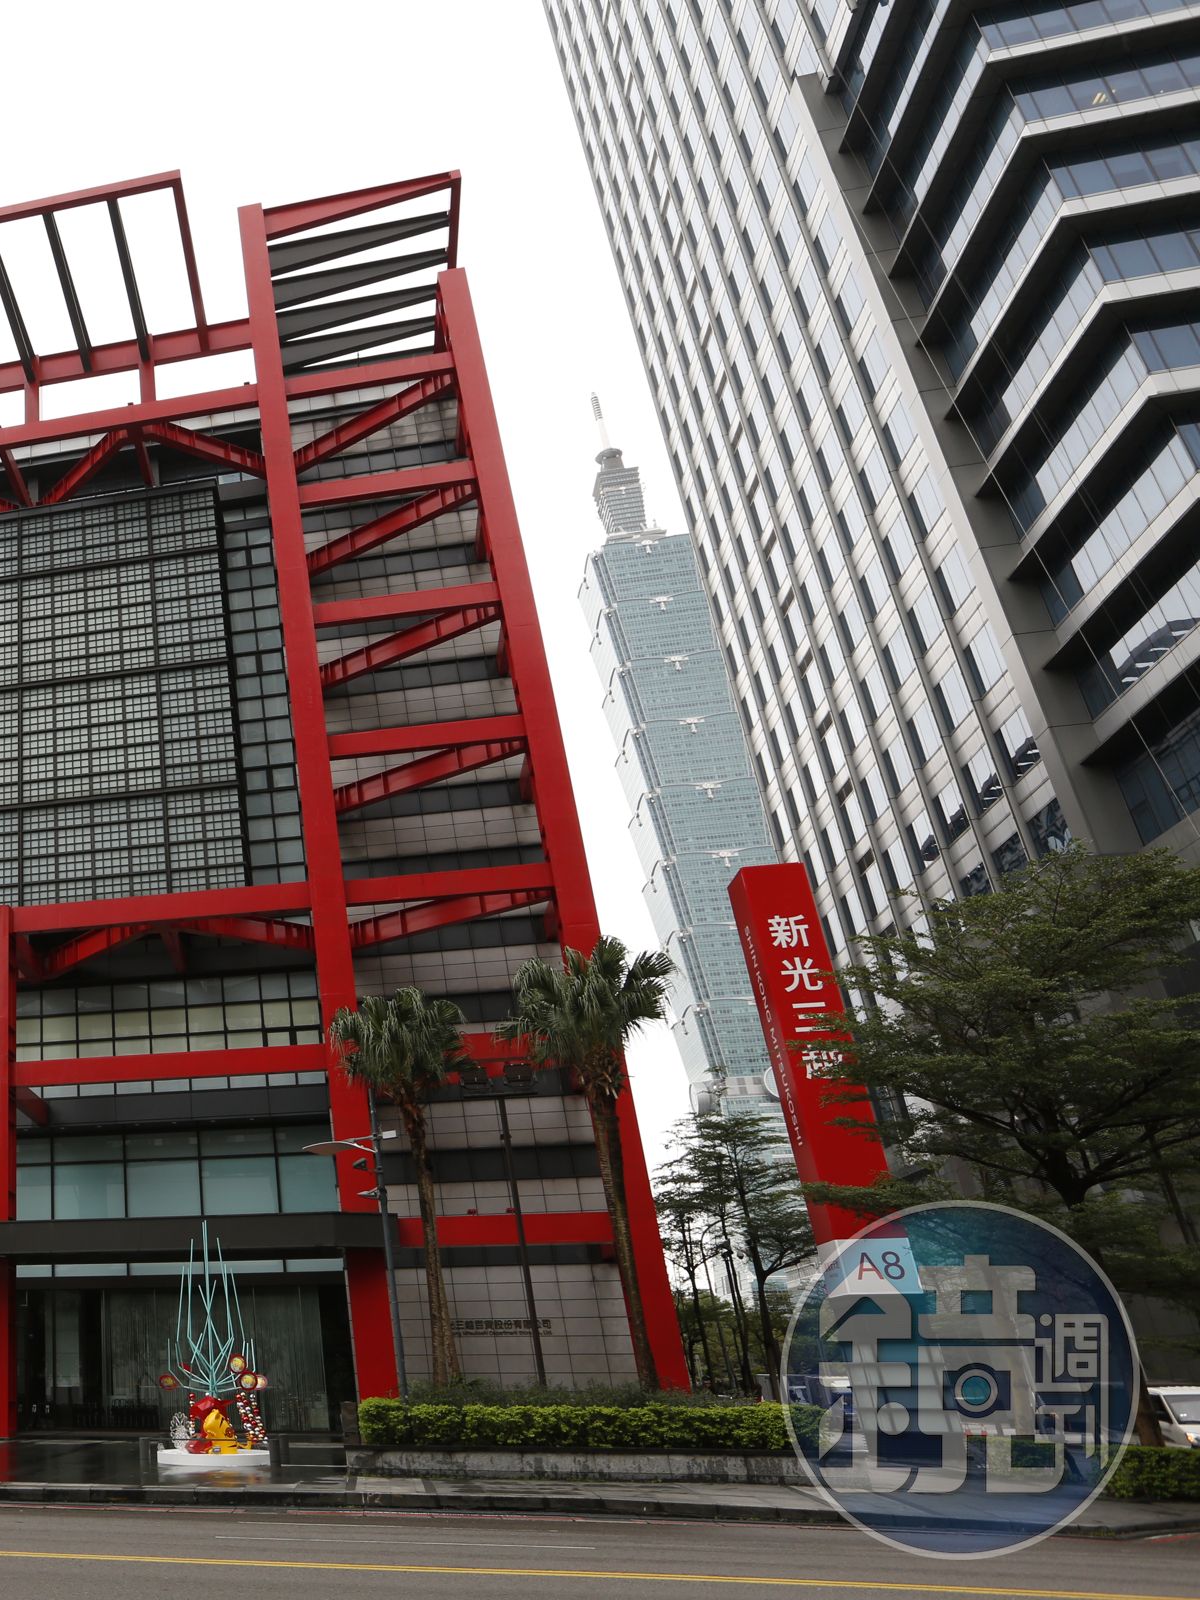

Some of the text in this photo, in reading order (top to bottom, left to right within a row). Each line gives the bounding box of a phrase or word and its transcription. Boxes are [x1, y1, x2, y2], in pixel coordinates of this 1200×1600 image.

[744, 925, 804, 1147] SHIN KONG MITSUKOSHI
[767, 914, 847, 1081] 新光三越
[858, 1251, 905, 1280] A8
